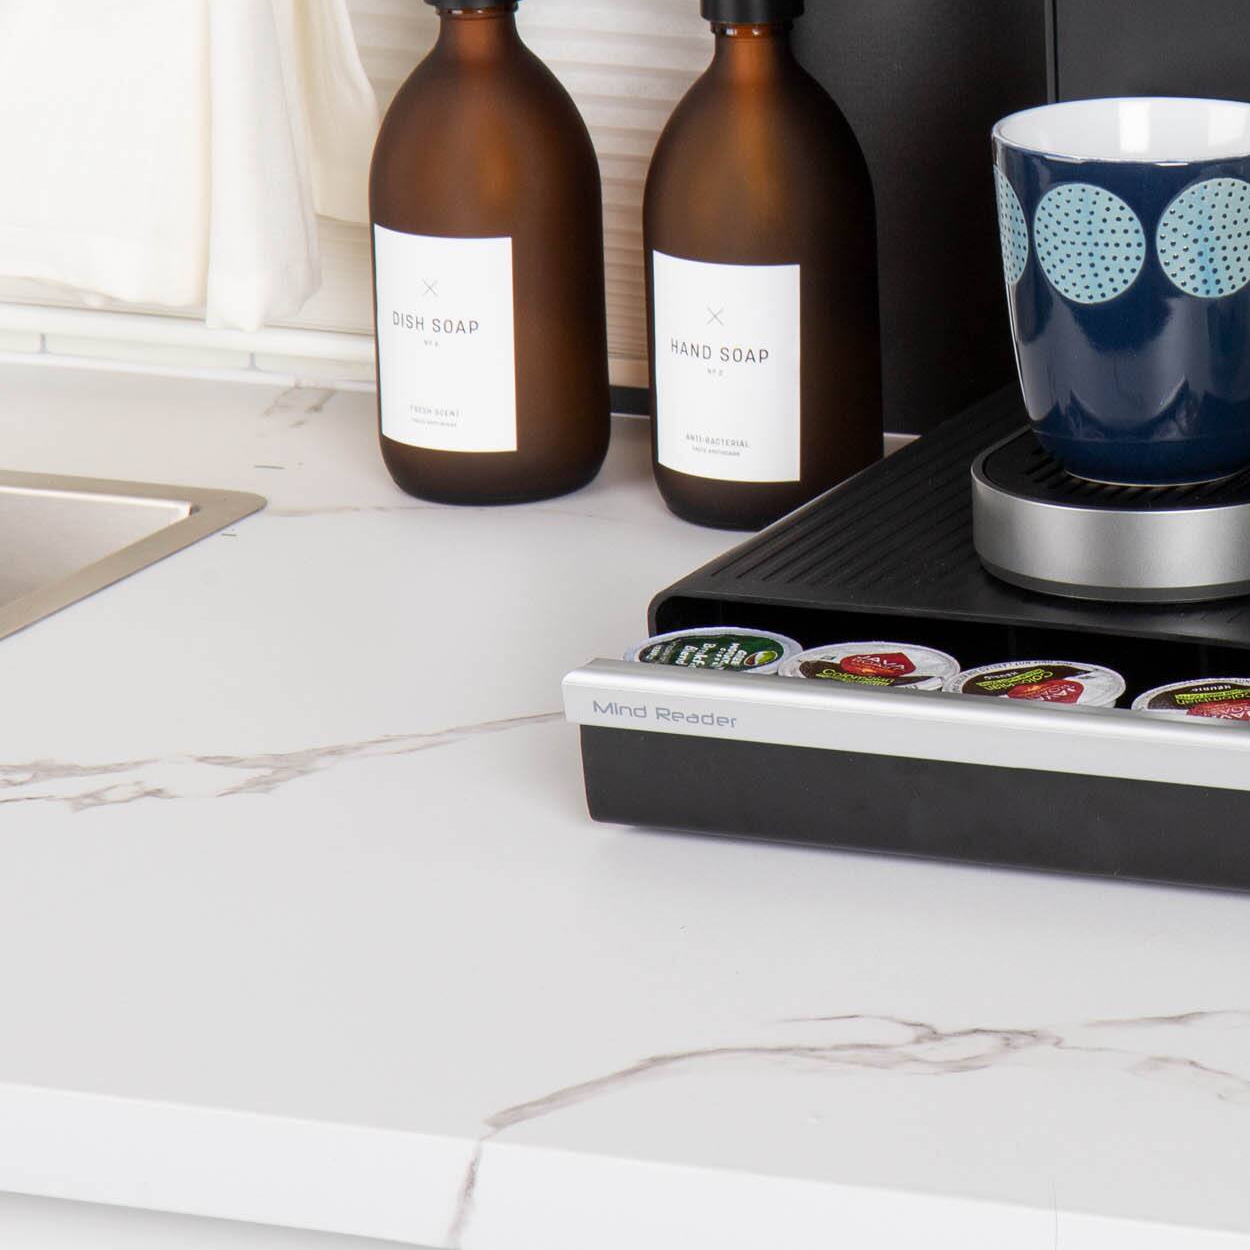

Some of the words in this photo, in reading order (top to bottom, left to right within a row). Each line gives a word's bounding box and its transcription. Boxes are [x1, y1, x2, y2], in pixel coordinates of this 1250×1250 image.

[393, 310, 424, 331] DISH
[432, 318, 479, 334] SOAP
[671, 337, 712, 360] HAND
[720, 347, 769, 363] SOAP
[685, 433, 750, 448] ANTI-BACTERIAL
[1191, 684, 1231, 692] KEURIG
[593, 700, 647, 718] Mind
[655, 707, 736, 728] Reader
